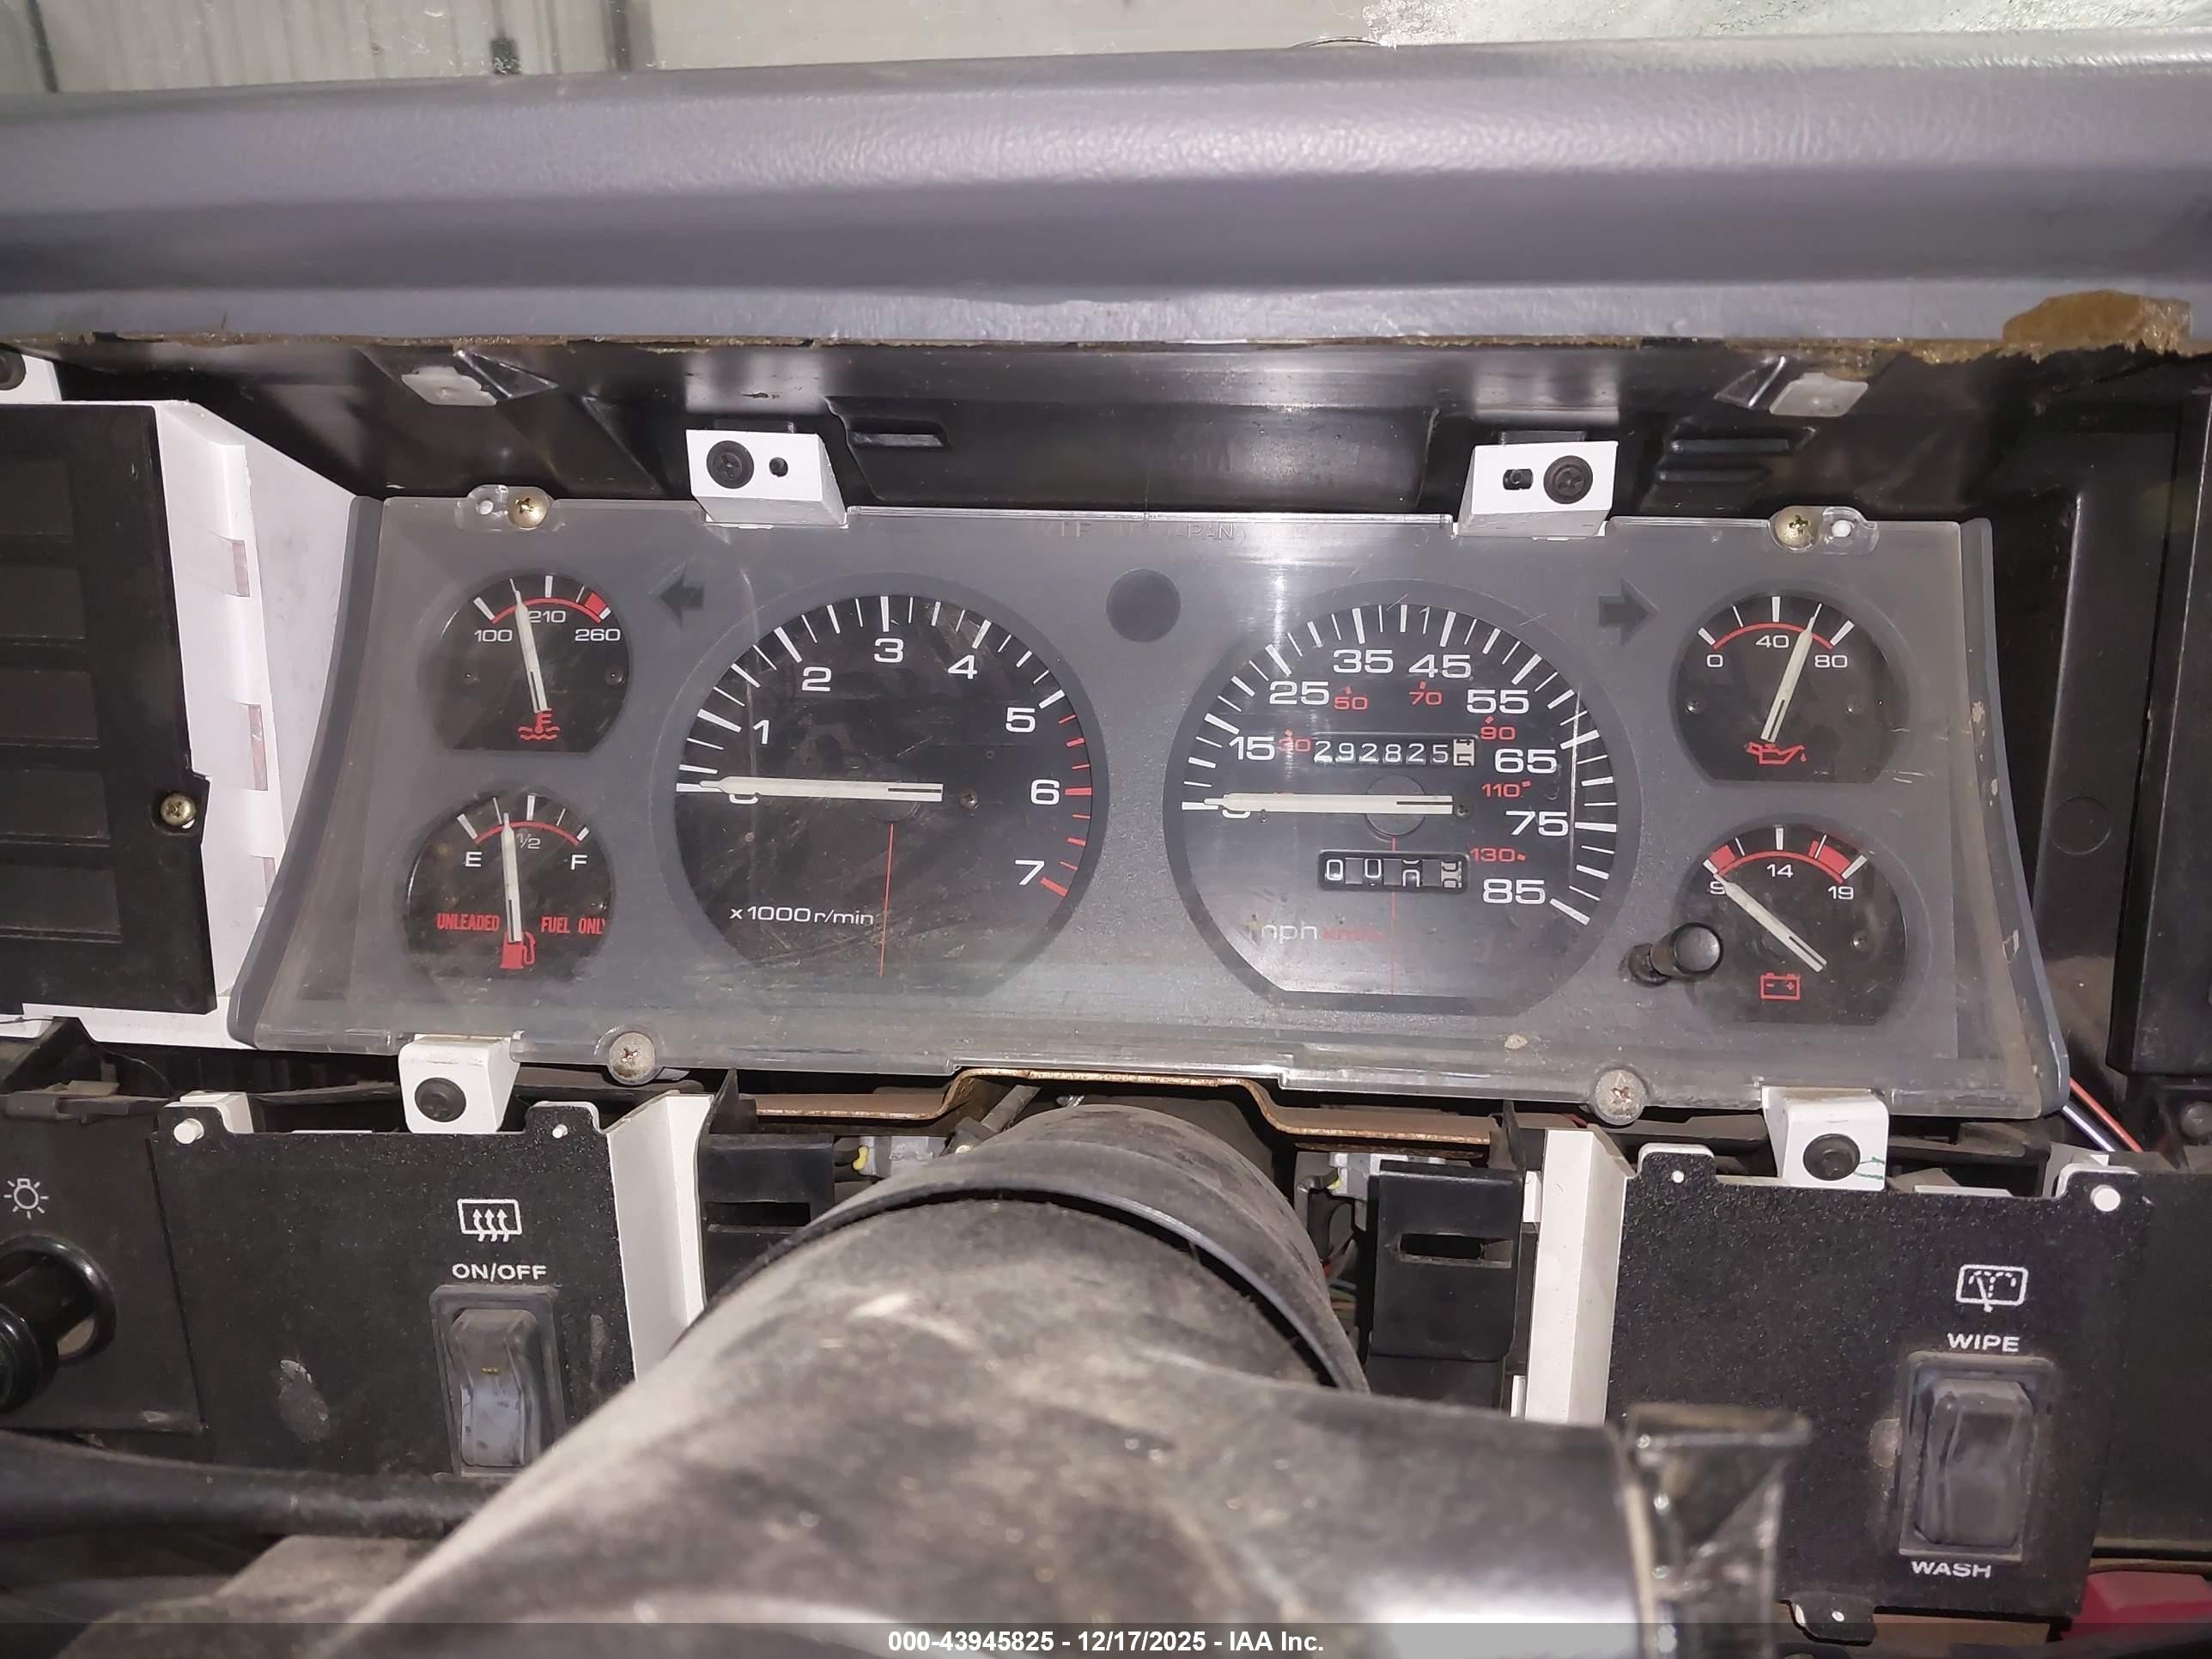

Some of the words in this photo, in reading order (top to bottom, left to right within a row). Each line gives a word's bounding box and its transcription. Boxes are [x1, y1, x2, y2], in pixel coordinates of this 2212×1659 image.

[528, 610, 566, 623] 210
[473, 629, 513, 642] 100
[574, 629, 621, 641] 260
[1755, 635, 1789, 648] 40
[873, 638, 904, 663] 3
[947, 654, 978, 679] 4
[1333, 649, 1395, 674] 35
[1408, 653, 1472, 678] 45
[1706, 654, 1723, 667] 0
[1814, 654, 1848, 668] 80
[801, 666, 832, 692] 2
[1269, 681, 1329, 705] 25
[1408, 691, 1443, 706] 70
[1466, 690, 1529, 714] 55
[1333, 696, 1369, 711] 50
[1005, 707, 1036, 732] 5
[752, 720, 769, 744] 1
[1480, 726, 1516, 740] 90
[1229, 736, 1275, 761] 15
[1494, 749, 1558, 774] 65
[1030, 780, 1060, 805] 6
[1481, 783, 1521, 799] 110
[1505, 811, 1569, 836] 75
[516, 834, 540, 849] 1/2
[465, 851, 482, 867] E
[570, 854, 587, 870] F
[1469, 848, 1516, 862] 130
[1015, 860, 1045, 885] 7
[1766, 864, 1794, 878] 14
[1483, 878, 1547, 904] 85
[1710, 881, 1727, 895] 9
[1828, 886, 1854, 900] 19
[436, 914, 501, 932] UNLEADED
[541, 916, 570, 933] FUEL
[452, 1262, 547, 1282] ON/OFF
[1947, 1332, 2021, 1352] WIPE
[1911, 1561, 1991, 1578] WASH
